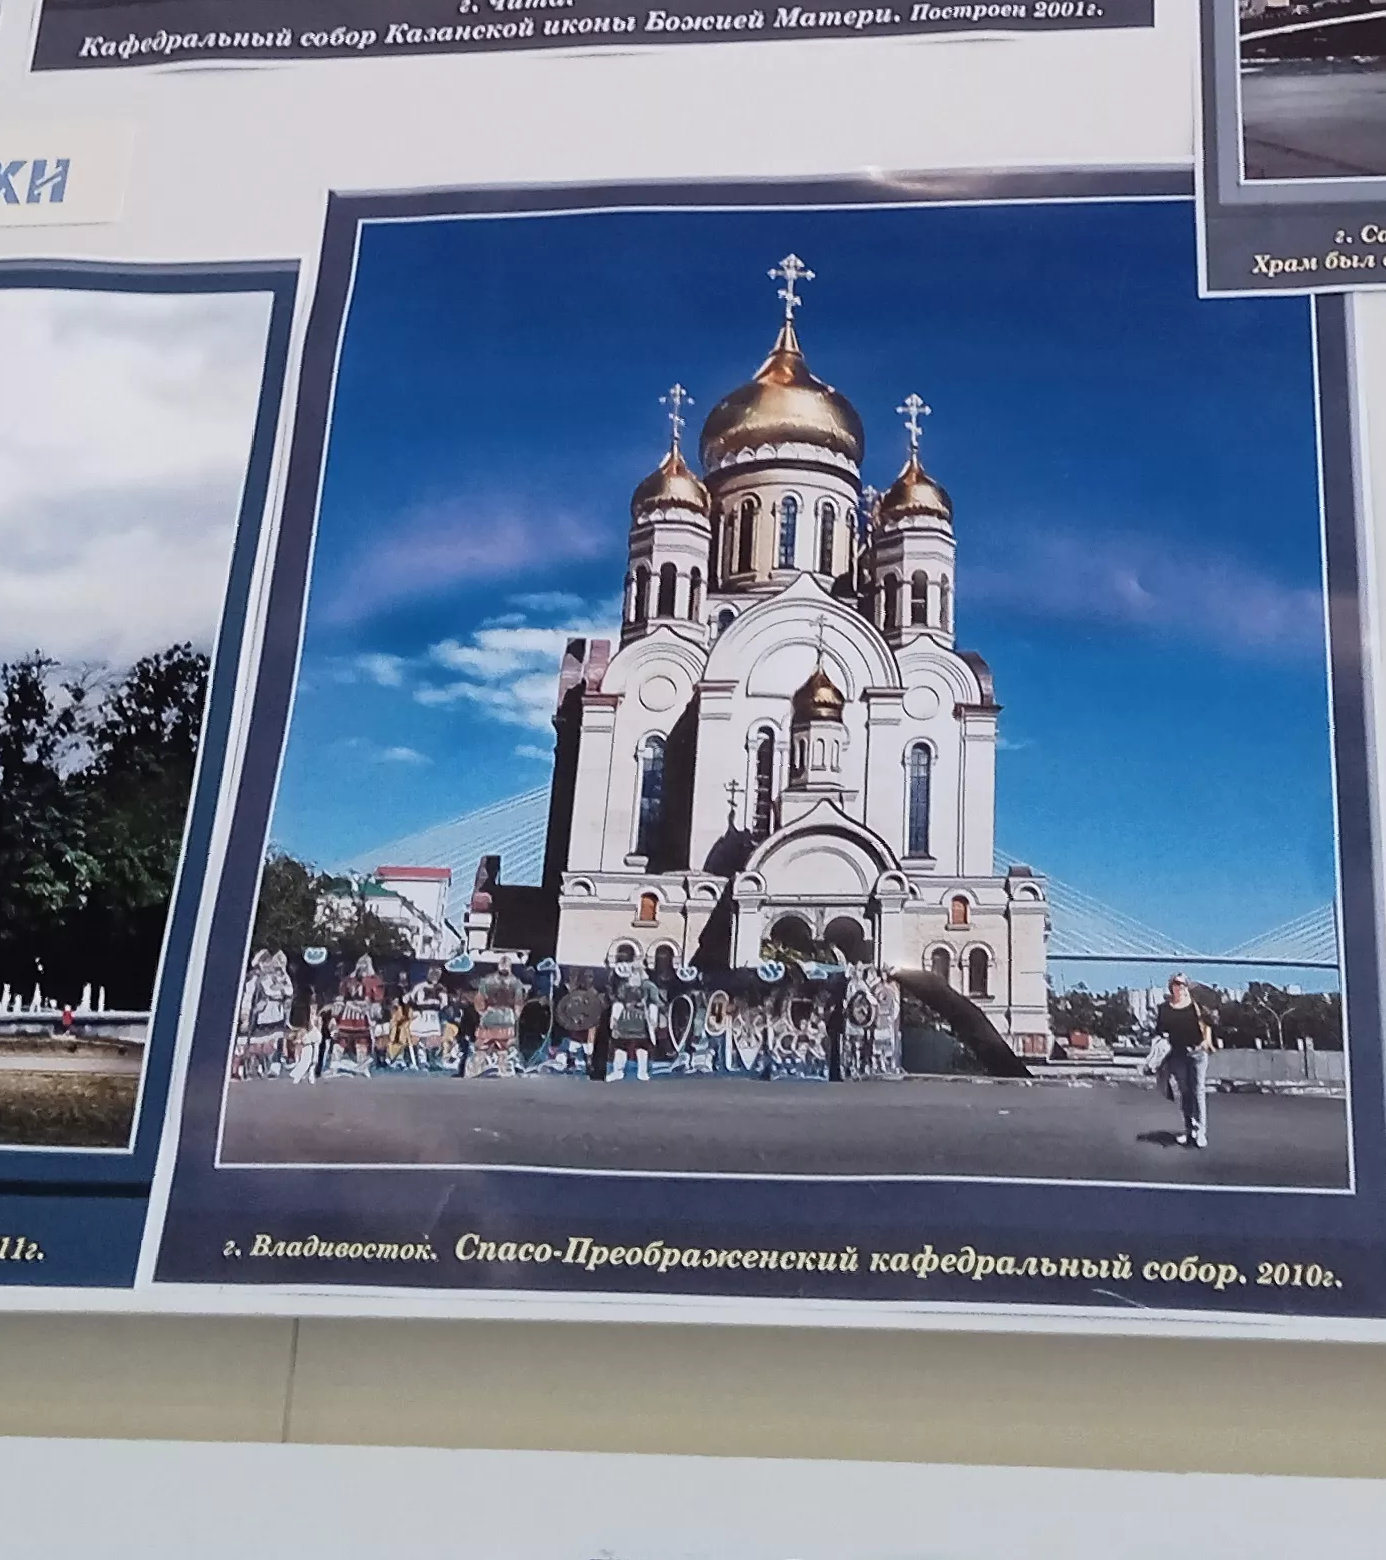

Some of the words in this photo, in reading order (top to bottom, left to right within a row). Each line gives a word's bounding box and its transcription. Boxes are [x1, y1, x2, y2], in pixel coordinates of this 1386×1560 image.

[79, 26, 292, 59] Кафедральный
[300, 25, 376, 49] собор
[384, 15, 535, 44] Казанской
[542, 11, 635, 36] иконы
[644, 7, 765, 31] Божией
[773, 5, 900, 30] Матери.
[910, 3, 1026, 22] Построен
[1033, 1, 1104, 18] 2001г.
[1334, 230, 1353, 245] г.
[1252, 255, 1318, 276] Храм
[1324, 249, 1376, 270] был
[222, 1241, 241, 1257] г.
[250, 1234, 438, 1263] Владивосток.
[455, 1233, 858, 1273] Спасо-Преображенский
[869, 1244, 1133, 1280] кафедральный
[1142, 1255, 1247, 1290] собор.
[1256, 1263, 1343, 1288] 2010г.
